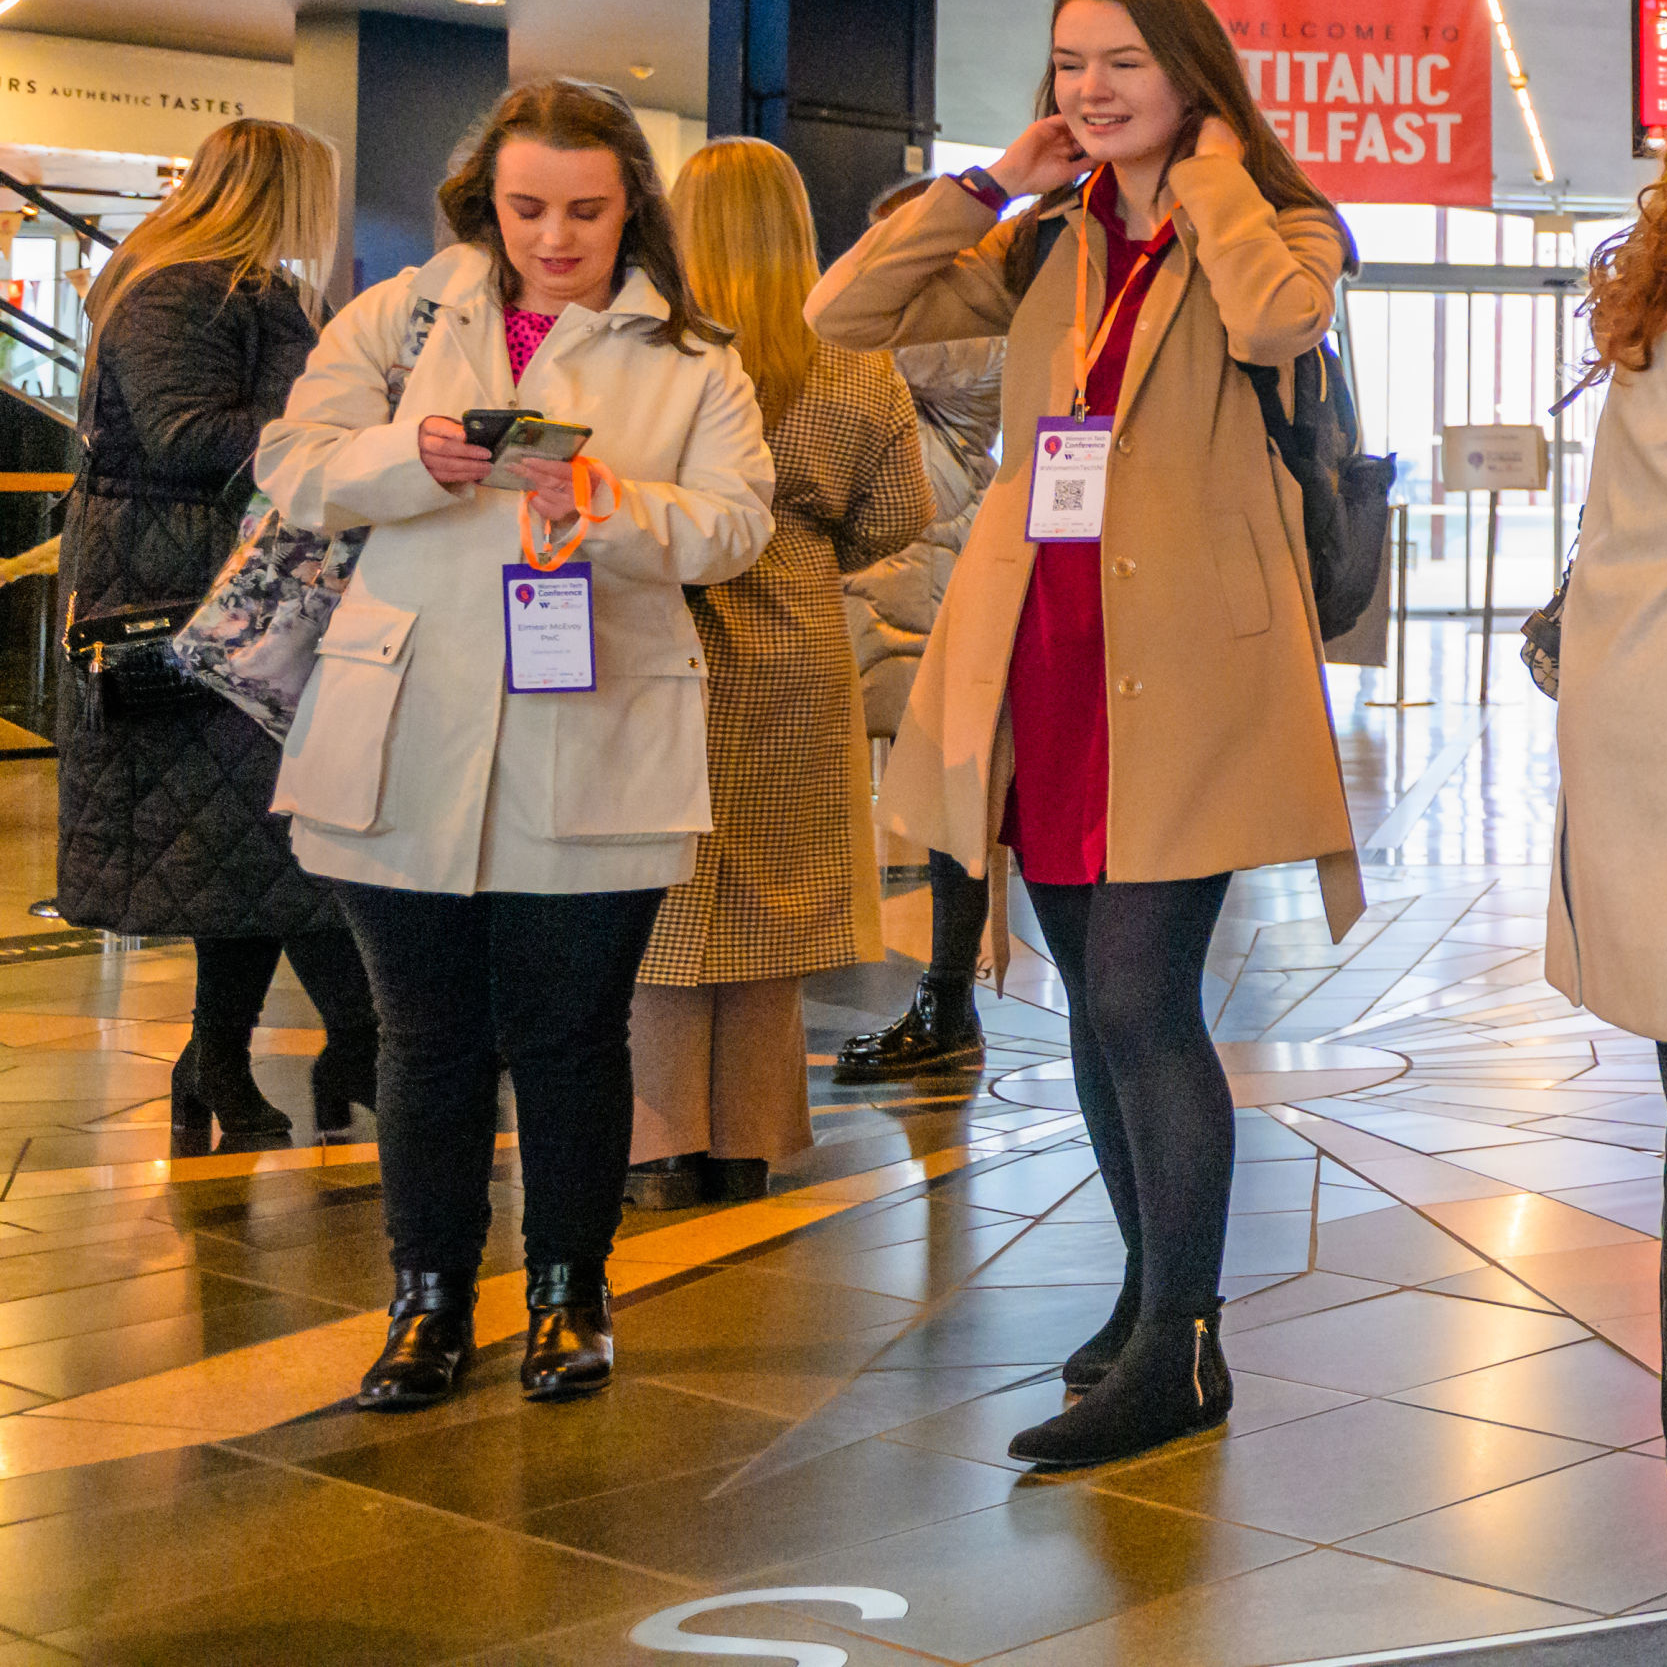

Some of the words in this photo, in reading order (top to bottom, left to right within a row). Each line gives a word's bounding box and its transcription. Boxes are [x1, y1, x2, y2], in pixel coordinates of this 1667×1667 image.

[1229, 18, 1395, 40] WELCOME
[1422, 24, 1460, 43] TO
[1238, 48, 1451, 106] TITANIC
[51, 86, 153, 107] AUTHENTIC
[159, 93, 245, 117] TASTES
[1262, 109, 1463, 165] LFAST
[538, 589, 583, 597] Conference
